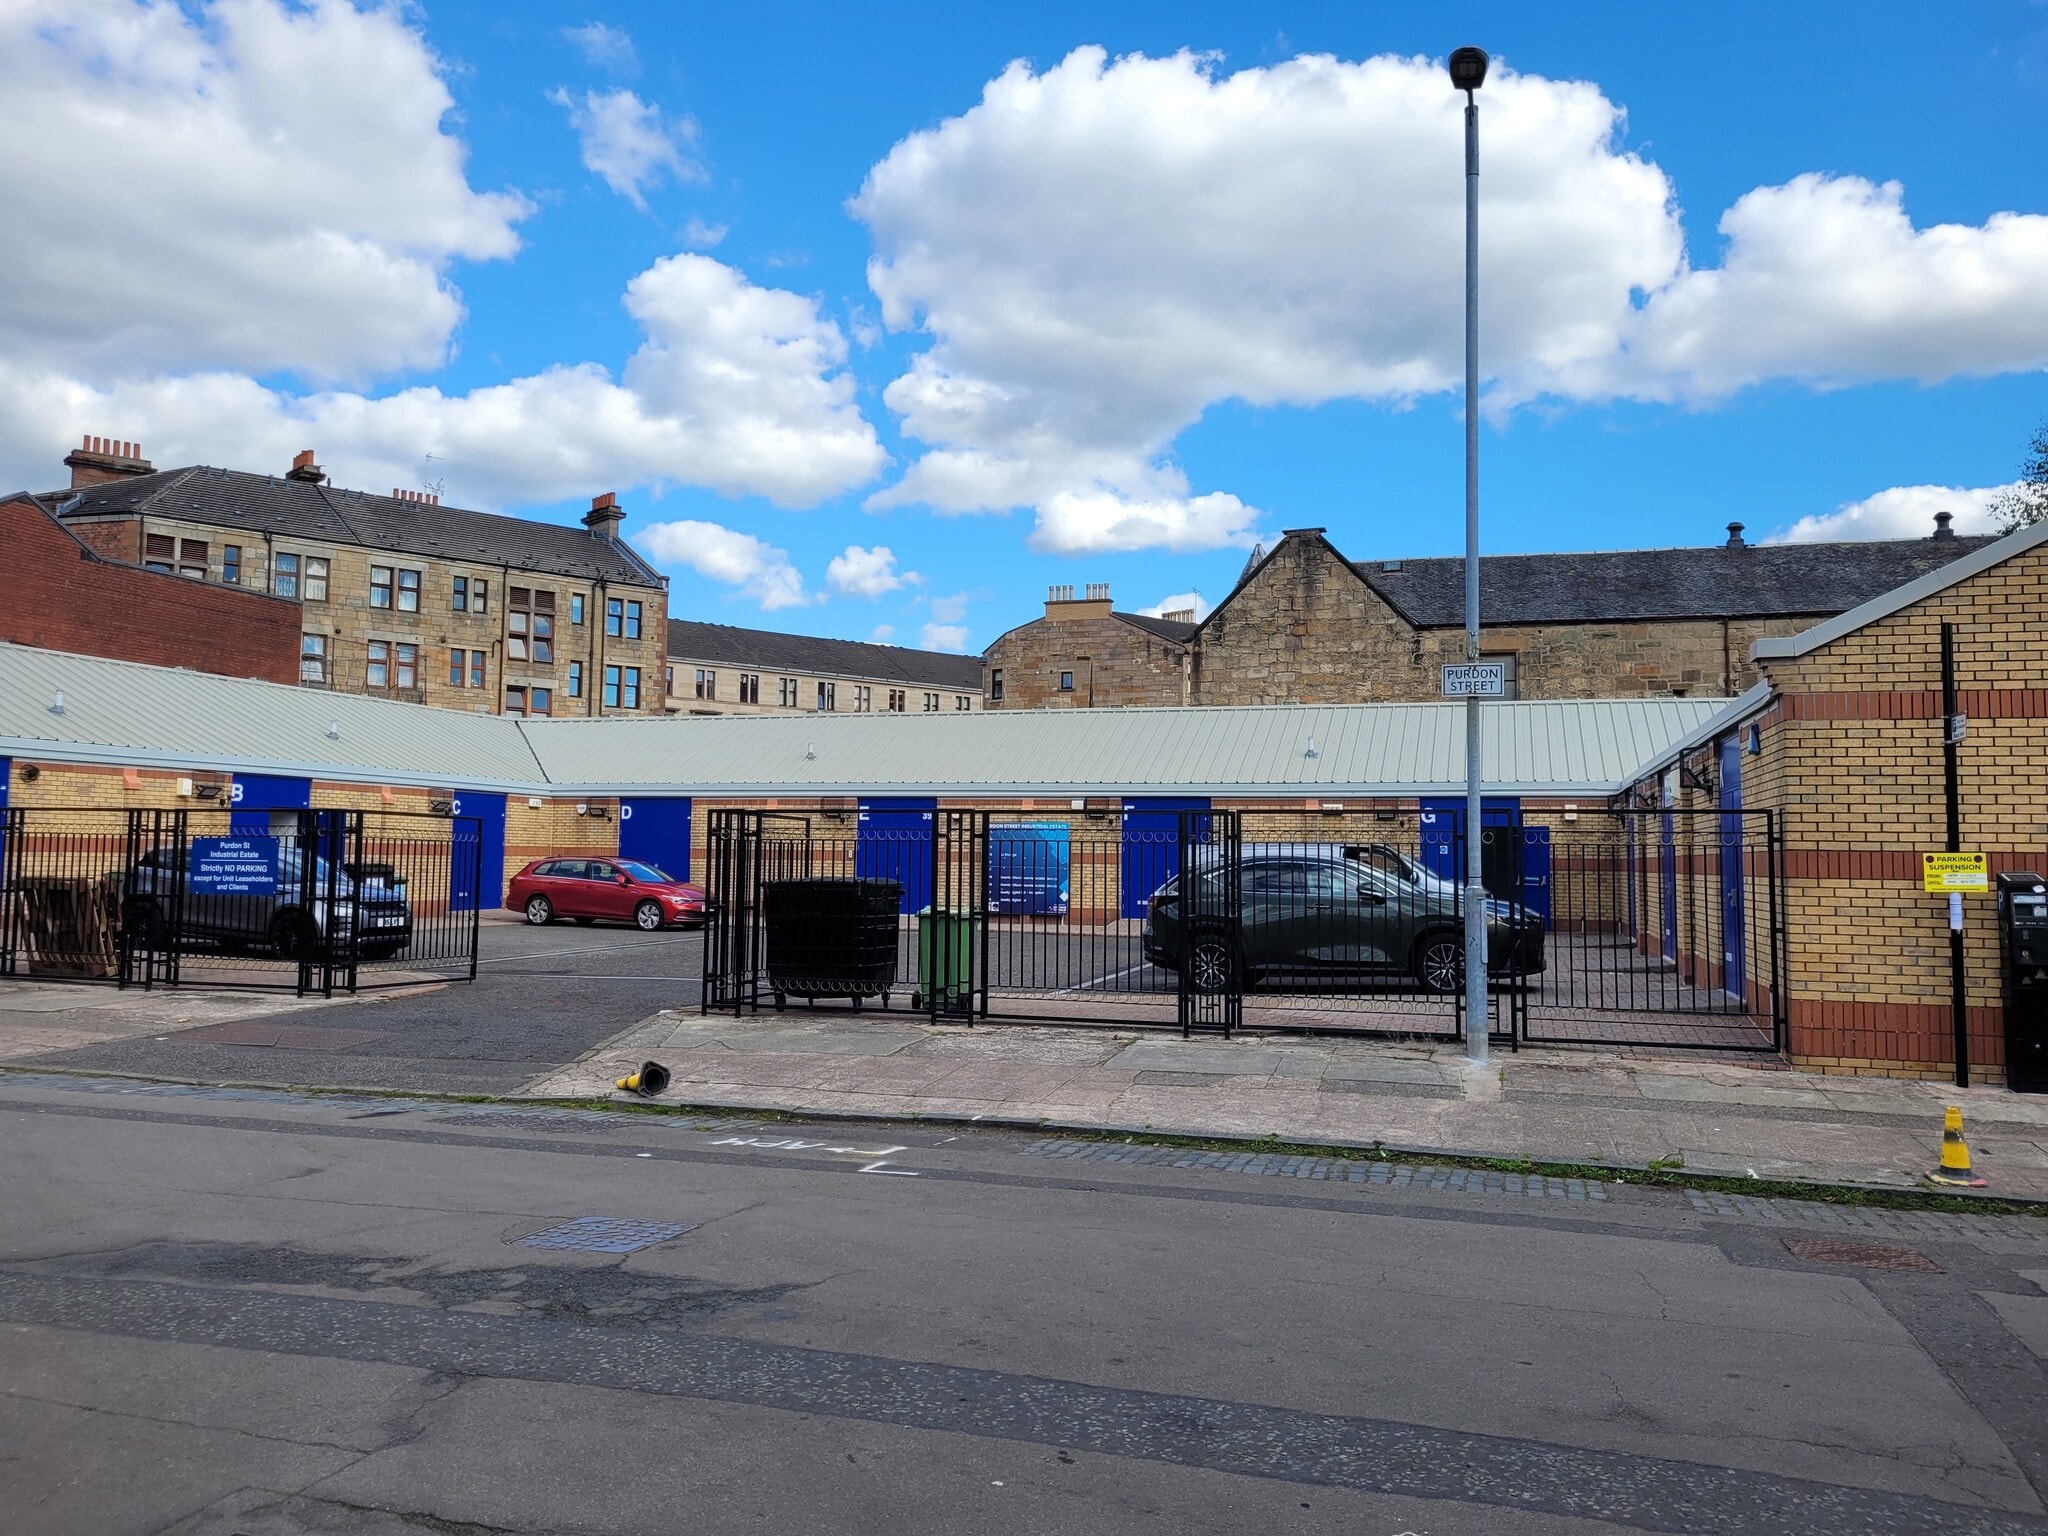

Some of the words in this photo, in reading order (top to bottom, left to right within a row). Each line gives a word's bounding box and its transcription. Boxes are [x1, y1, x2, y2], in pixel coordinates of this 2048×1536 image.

[1447, 669, 1498, 679] PURDON
[1450, 681, 1495, 691] STREET
[231, 783, 244, 801] B
[453, 800, 461, 815] C
[621, 805, 632, 820] D
[859, 806, 870, 820] E
[1421, 807, 1436, 823] G
[200, 864, 224, 873] Strictly
[236, 865, 268, 873] PARKING
